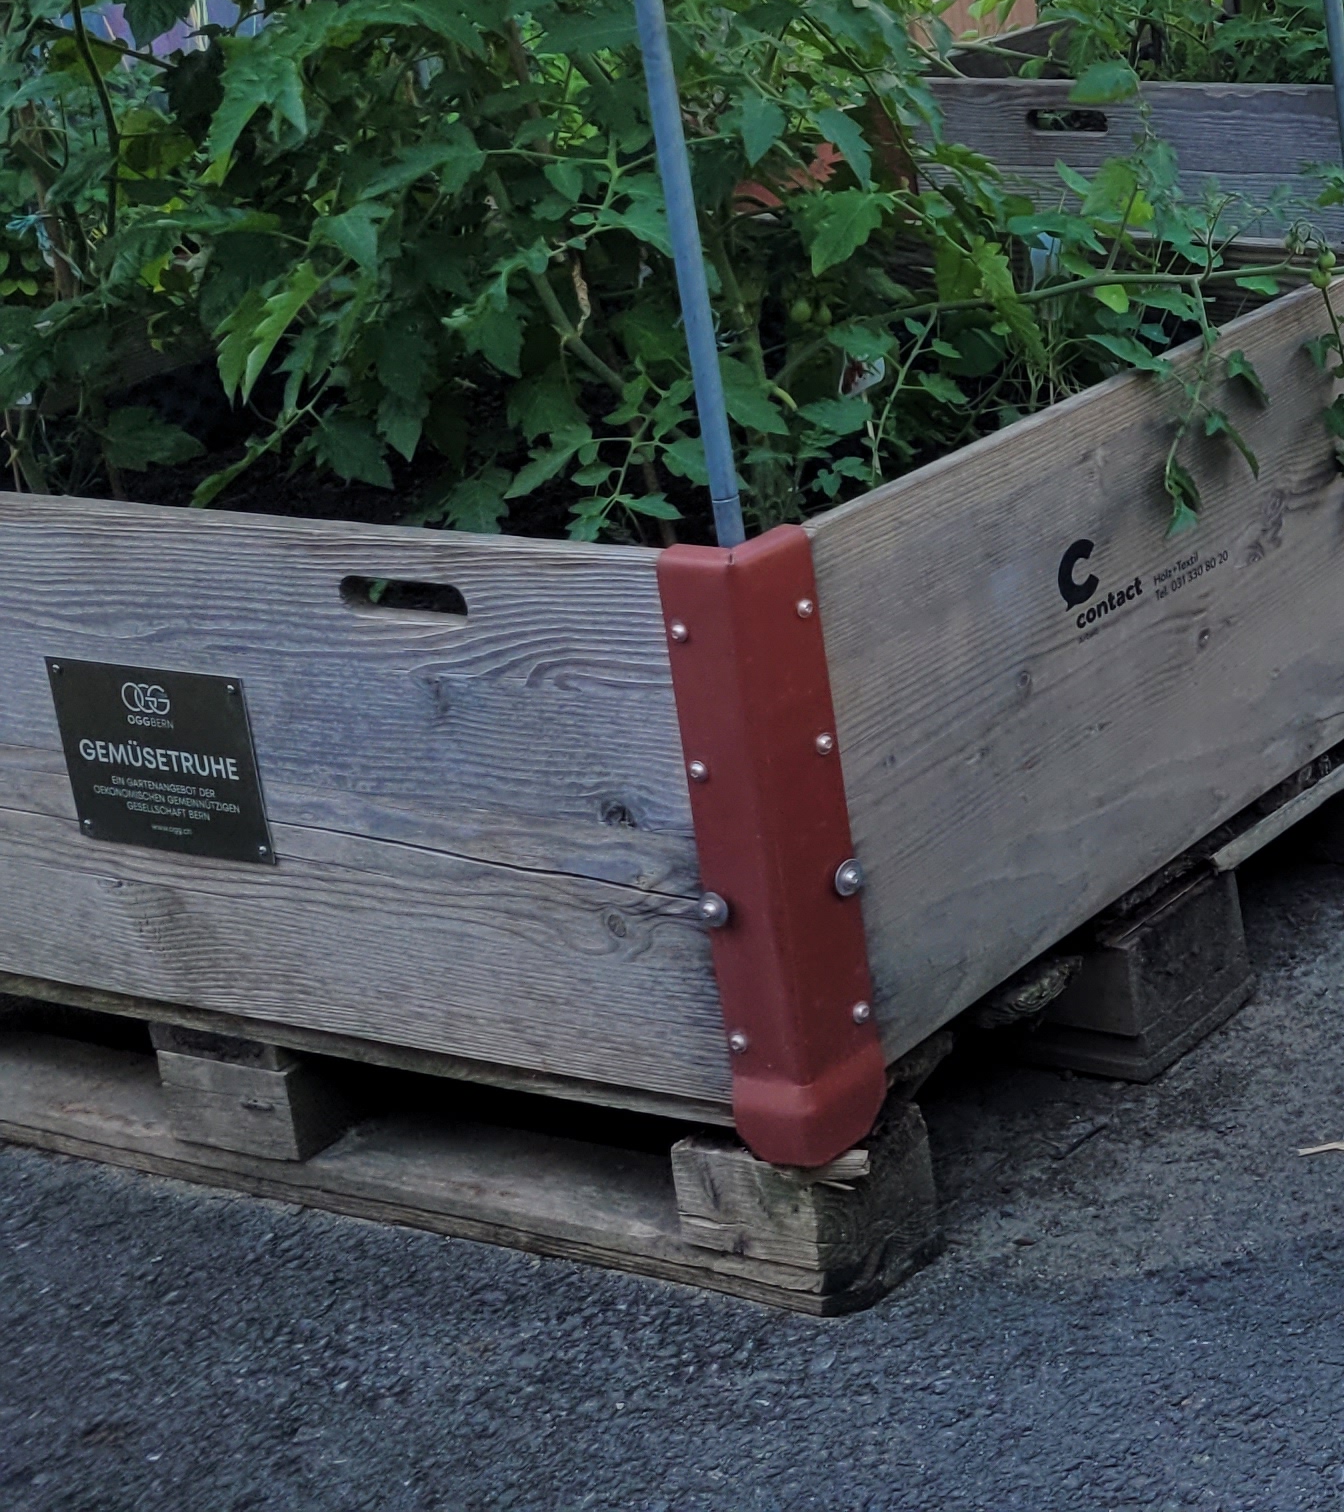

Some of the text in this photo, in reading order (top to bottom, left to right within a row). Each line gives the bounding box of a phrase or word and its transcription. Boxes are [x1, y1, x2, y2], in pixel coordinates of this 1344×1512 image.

[1171, 574, 1186, 592] 031
[1187, 565, 1203, 582] 330
[1204, 557, 1216, 572] 80
[1218, 550, 1228, 564] 20
[1076, 577, 1143, 628] contact
[79, 739, 240, 780] GEMÜSETRUHE
[93, 784, 240, 814] OEKONOMISCHEN GEMEINNÜTZIGEN
[111, 775, 216, 798] EIN GARTENANGEBOT DER
[126, 801, 211, 821] GESELLSCHAFT BERN
